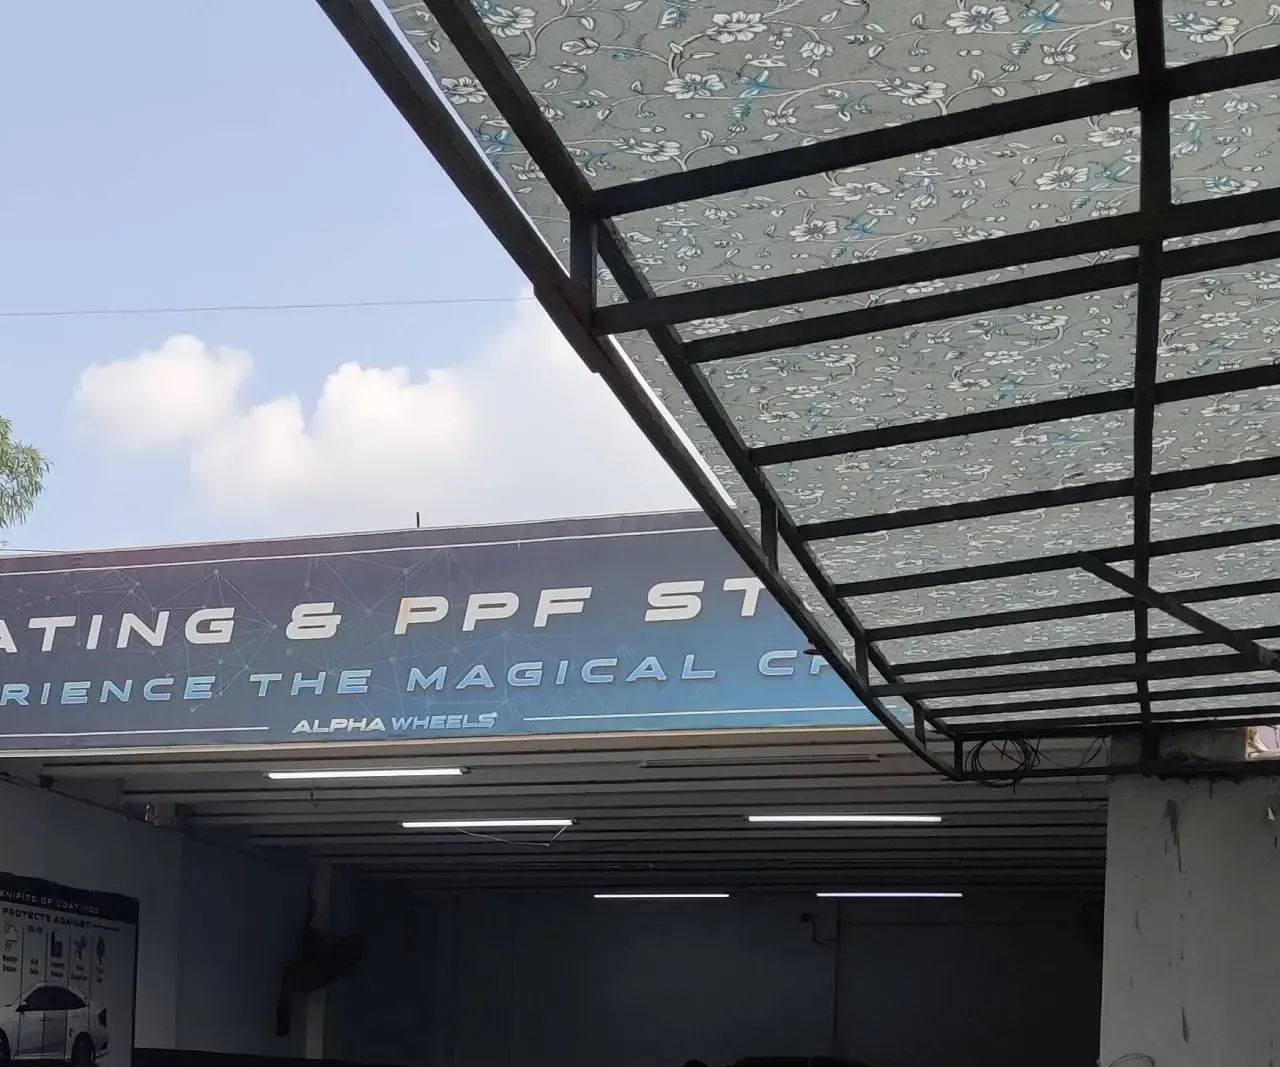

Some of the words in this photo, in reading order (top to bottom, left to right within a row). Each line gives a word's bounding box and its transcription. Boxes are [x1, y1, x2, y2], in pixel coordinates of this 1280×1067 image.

[286, 602, 342, 640] &
[394, 586, 592, 635] PPF
[249, 669, 372, 696] THE
[406, 654, 716, 692] MAGICAL
[291, 717, 386, 734] ALPHA
[391, 712, 498, 730] WHEELS
